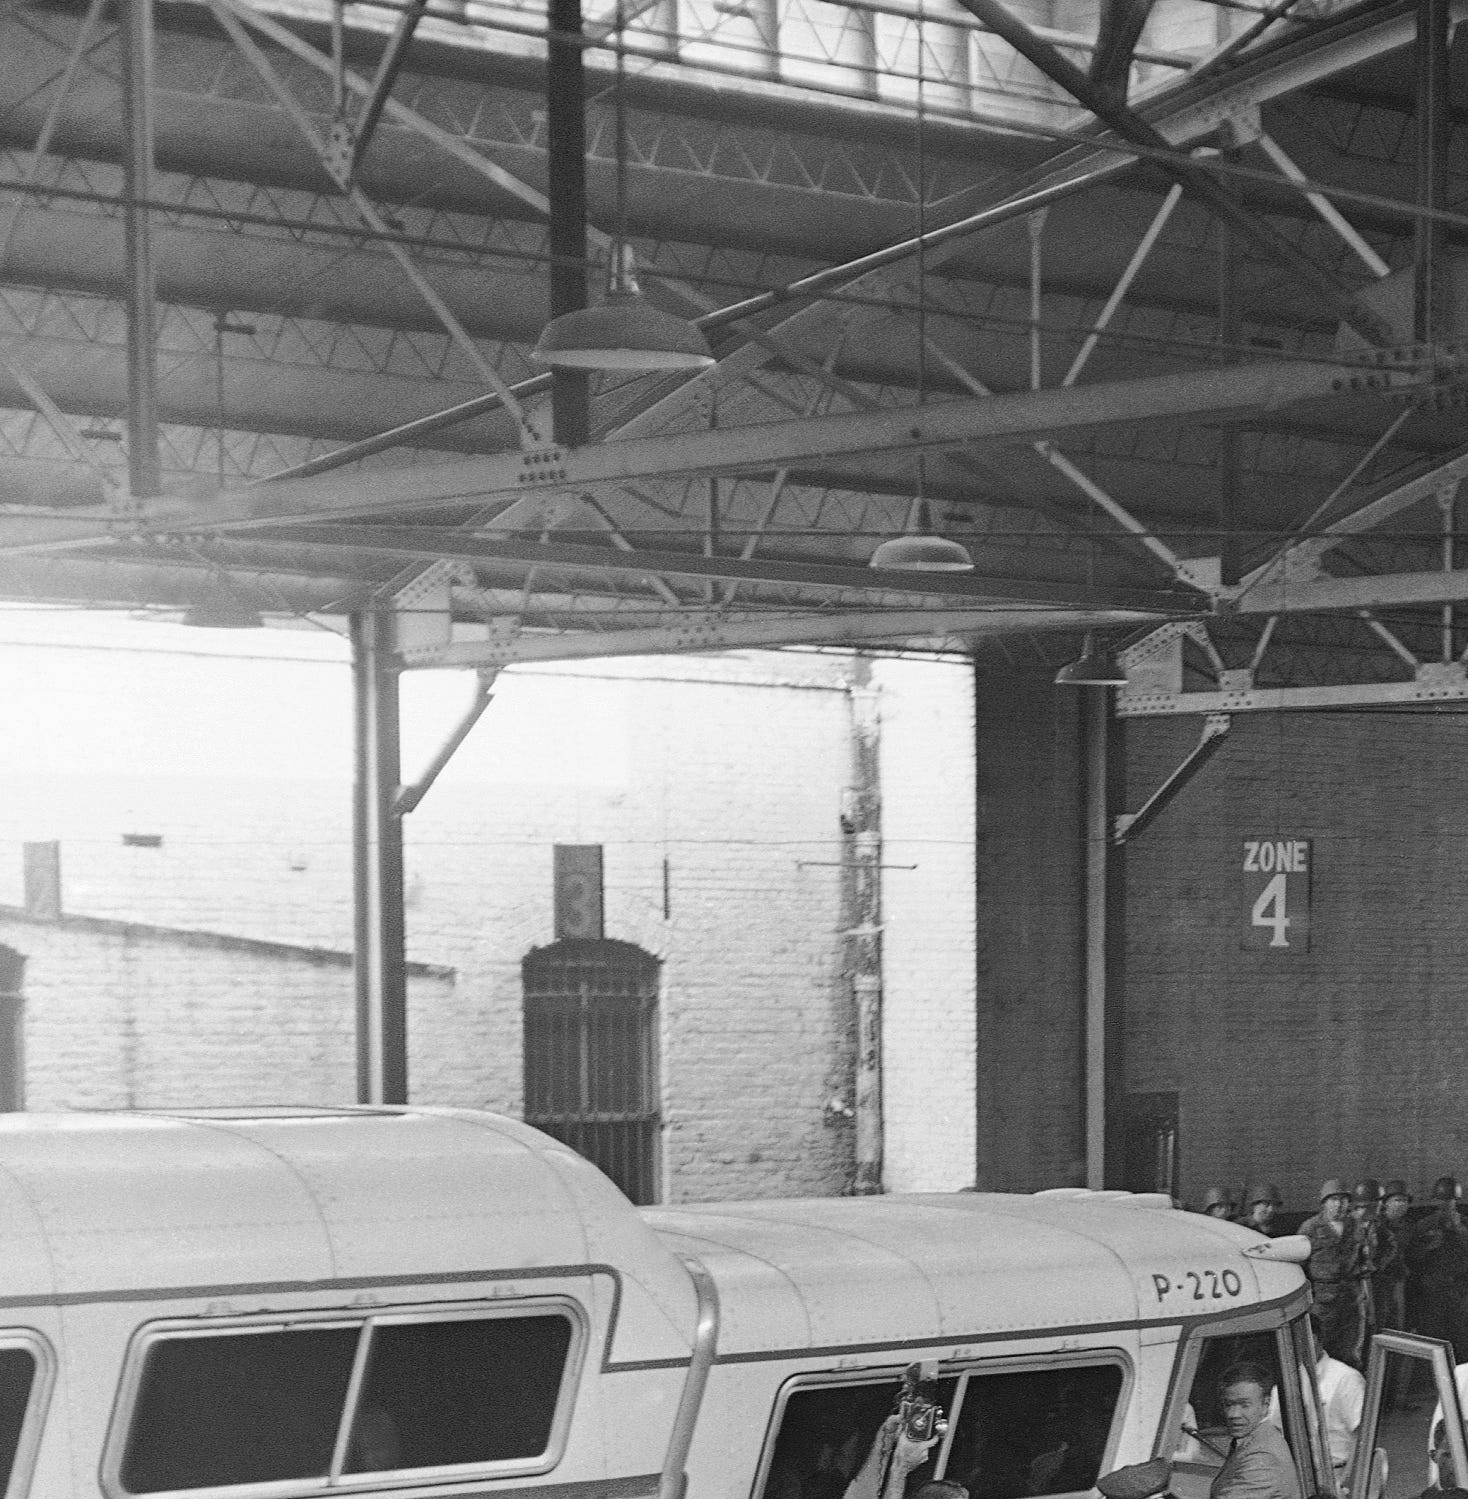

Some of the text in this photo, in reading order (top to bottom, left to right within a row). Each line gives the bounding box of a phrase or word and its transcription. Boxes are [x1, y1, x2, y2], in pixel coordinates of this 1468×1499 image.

[1243, 841, 1308, 872] ZONE
[563, 873, 593, 936] 3
[1251, 873, 1290, 947] 4
[1152, 1268, 1242, 1302] P-220
